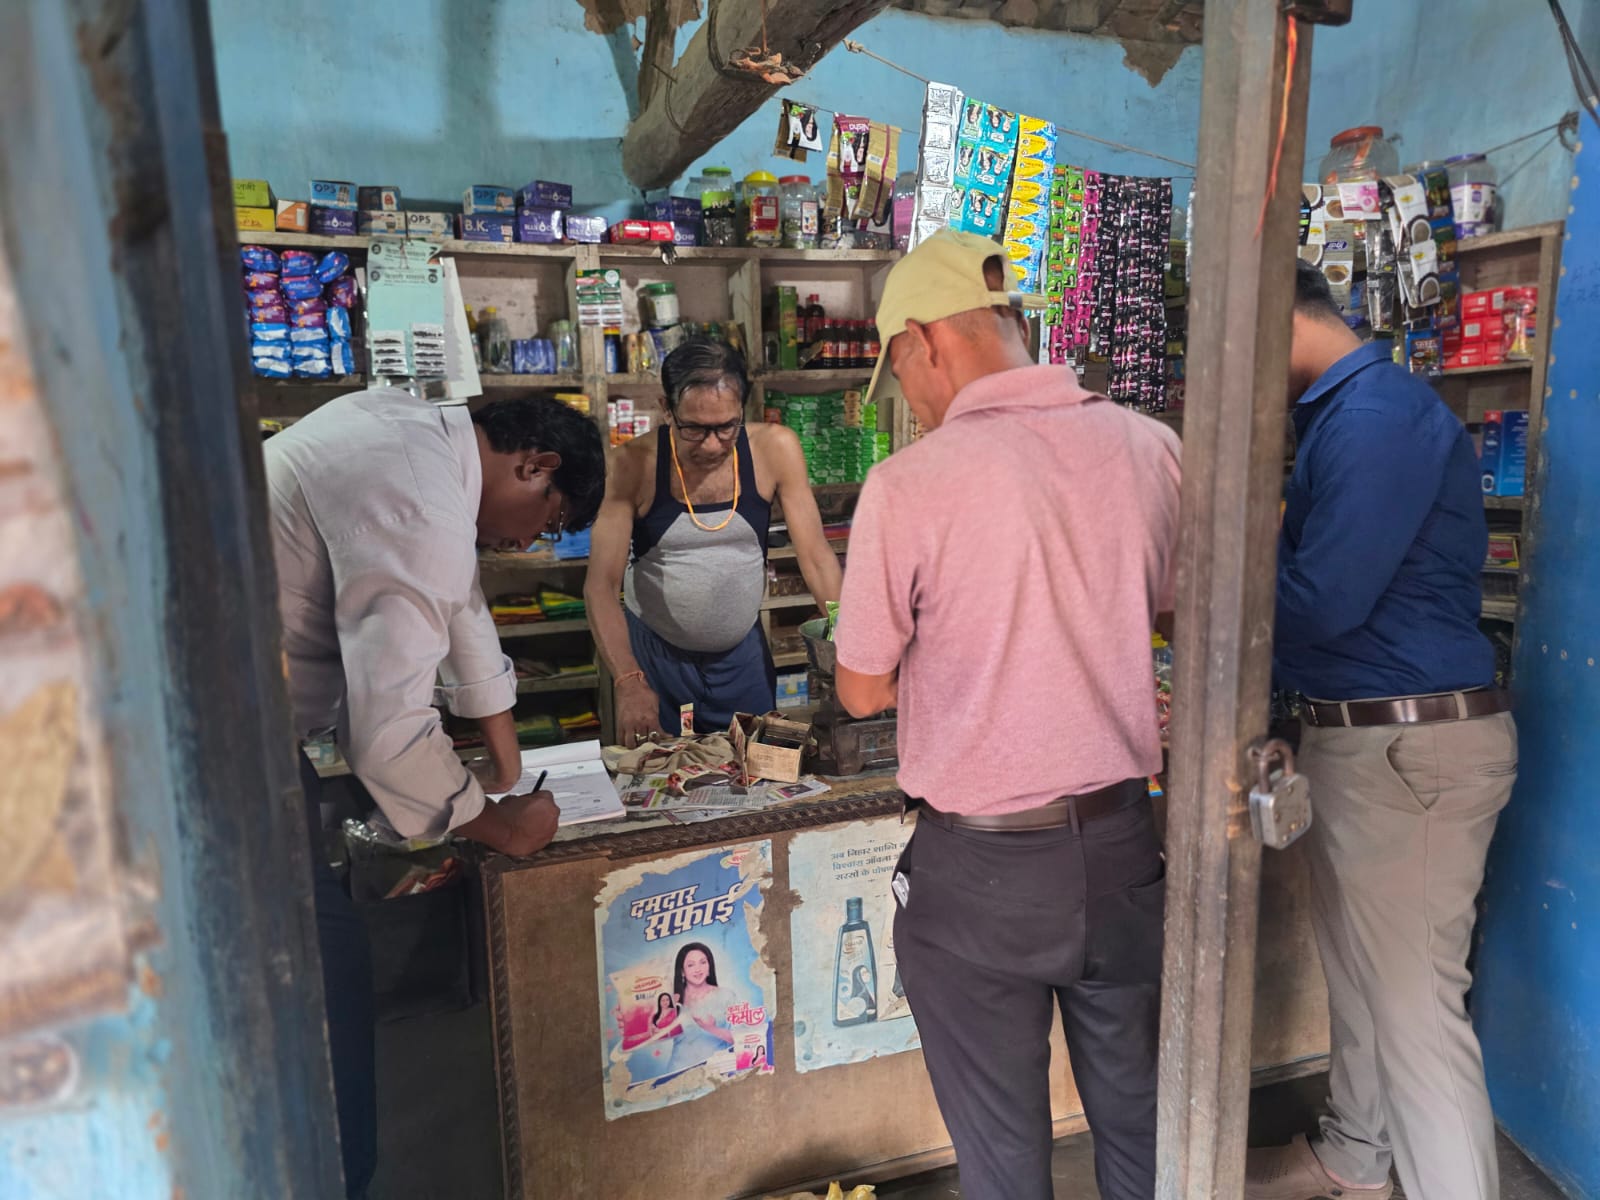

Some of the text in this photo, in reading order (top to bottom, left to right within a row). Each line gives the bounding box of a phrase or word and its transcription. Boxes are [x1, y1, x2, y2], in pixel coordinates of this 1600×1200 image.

[314, 183, 337, 194] OPS
[410, 214, 431, 224] OPS
[465, 219, 489, 232] B.K.
[630, 884, 700, 919] दमदार
[727, 1006, 766, 1026] कमाल
